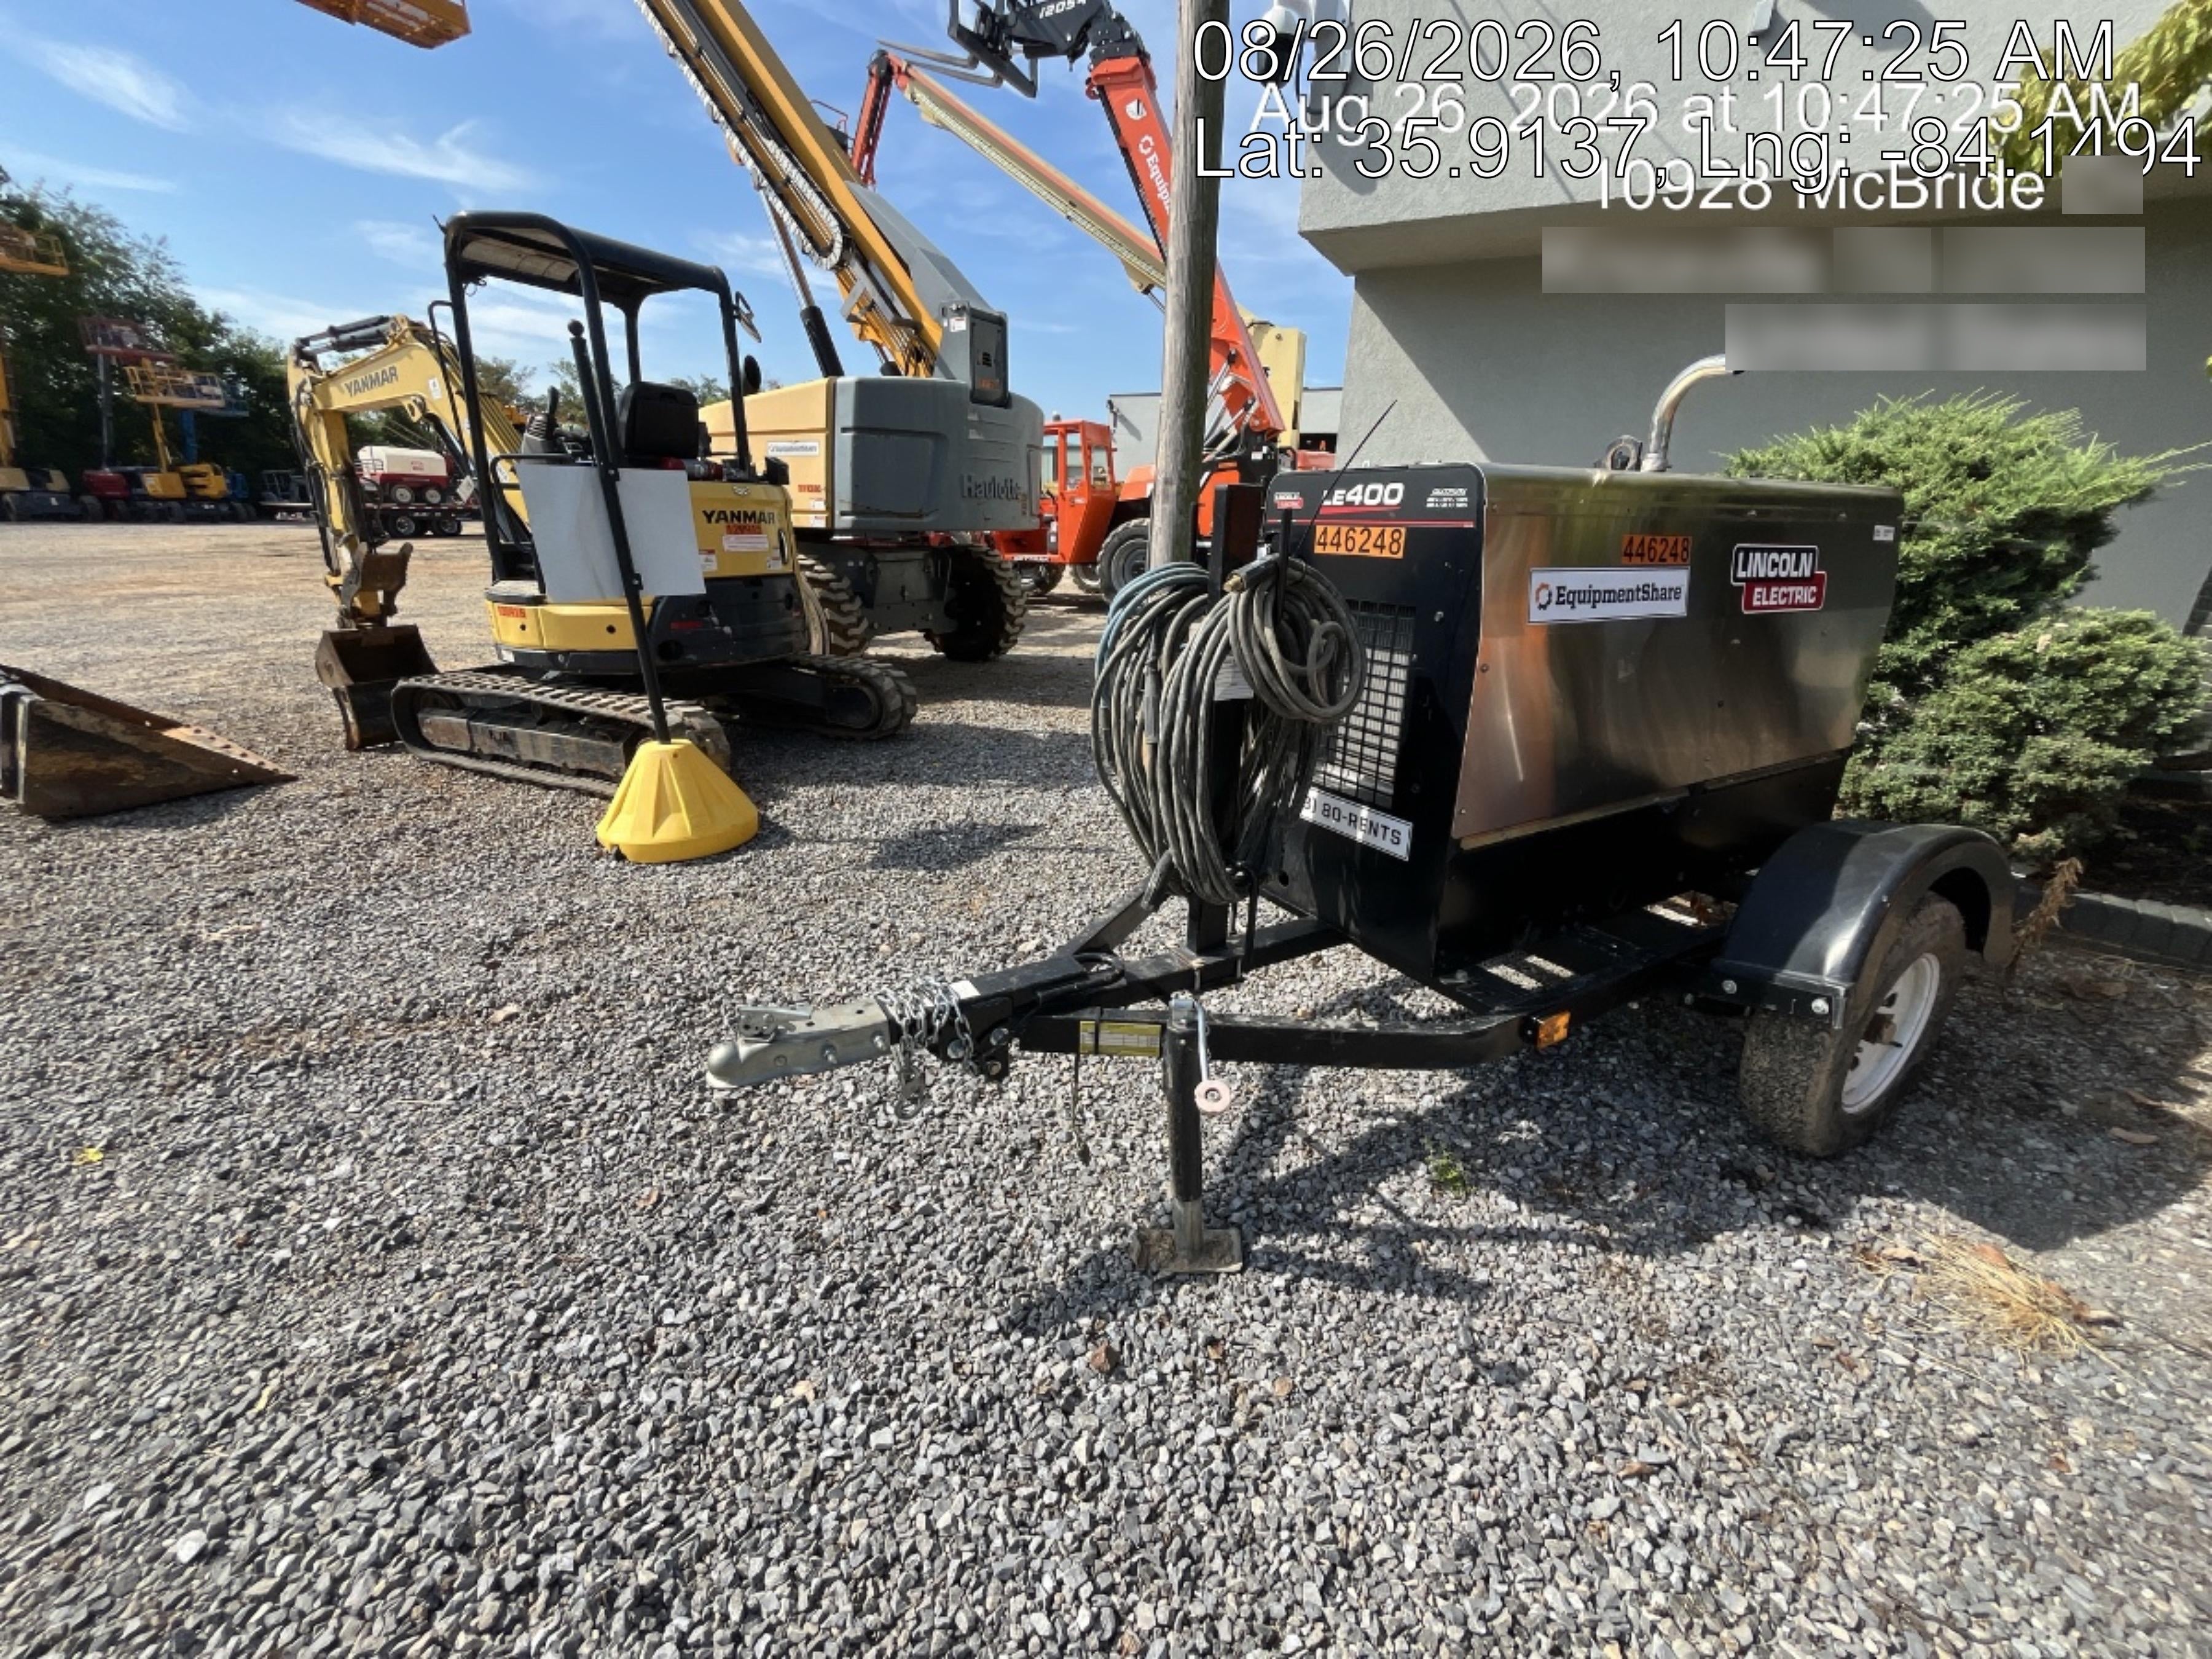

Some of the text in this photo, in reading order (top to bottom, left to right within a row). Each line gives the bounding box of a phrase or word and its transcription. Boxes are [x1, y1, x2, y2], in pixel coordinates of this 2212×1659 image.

[345, 366, 398, 397] YANMAR
[1322, 482, 1405, 506] LE400
[702, 510, 775, 524] YANMAR
[1317, 527, 1402, 555] 446248
[1623, 536, 1690, 563] 446248
[1736, 551, 1813, 578] LINCOLN
[1555, 582, 1682, 609] EquipmentShare
[1752, 586, 1817, 607] ELECTRIC
[1322, 803, 1402, 845] 80-RENTS
